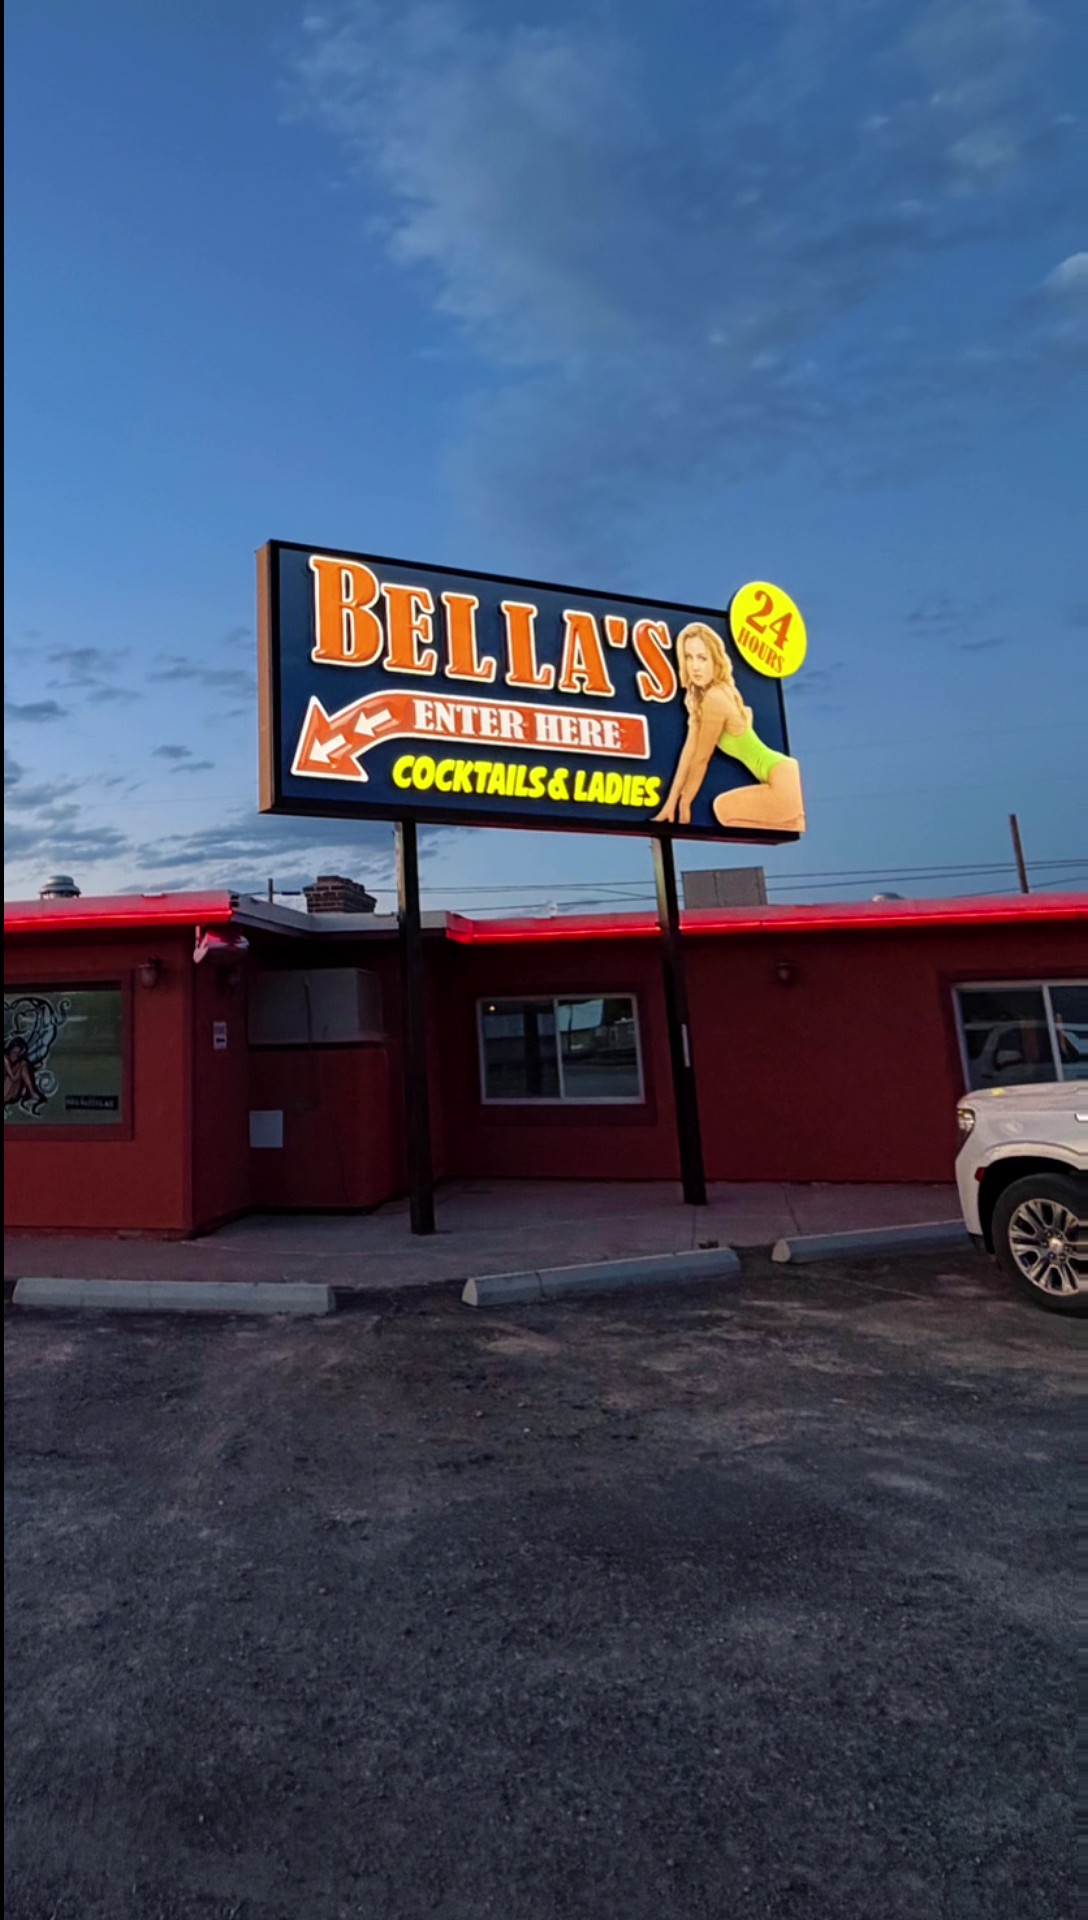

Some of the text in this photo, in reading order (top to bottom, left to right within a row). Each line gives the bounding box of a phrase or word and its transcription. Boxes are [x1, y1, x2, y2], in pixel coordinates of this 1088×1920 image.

[309, 555, 677, 702] BELLA'S
[745, 590, 793, 651] 24
[737, 626, 785, 674] HOURS
[413, 699, 622, 749] ENTER HERE
[392, 755, 548, 798] COCKTAILS
[573, 770, 661, 807] LADIES
